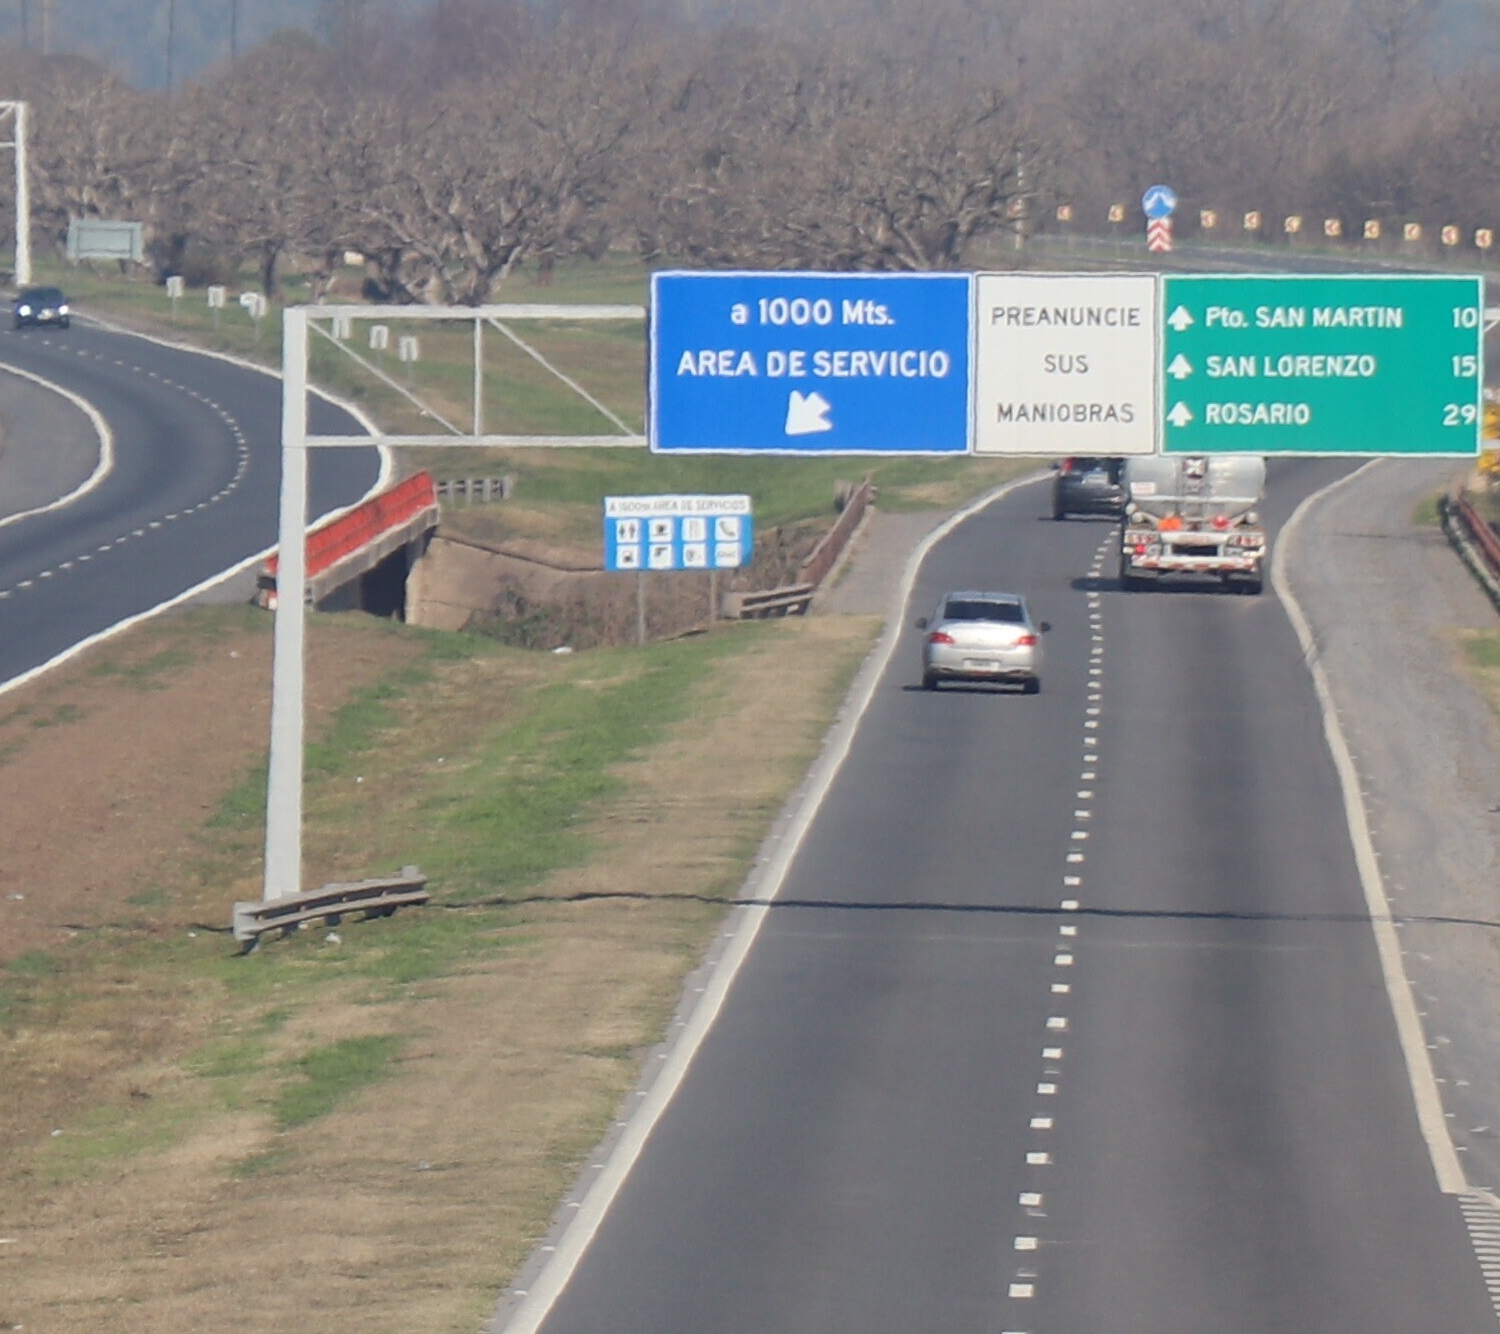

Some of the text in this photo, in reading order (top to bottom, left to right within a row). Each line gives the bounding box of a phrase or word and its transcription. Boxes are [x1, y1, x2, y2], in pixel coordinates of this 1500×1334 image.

[730, 298, 895, 326] a 1000 Mts.
[991, 306, 1141, 327] PREANUNCIE
[1205, 306, 1478, 328] Pto. SAN MARTIN 10
[676, 350, 949, 378] AREA DE SERVICIO
[1043, 353, 1090, 374] SUS
[1205, 355, 1478, 377] SAN LORENZO 15
[996, 402, 1135, 424] MANIOBRAS
[1205, 403, 1477, 427] ROSARIO 29
